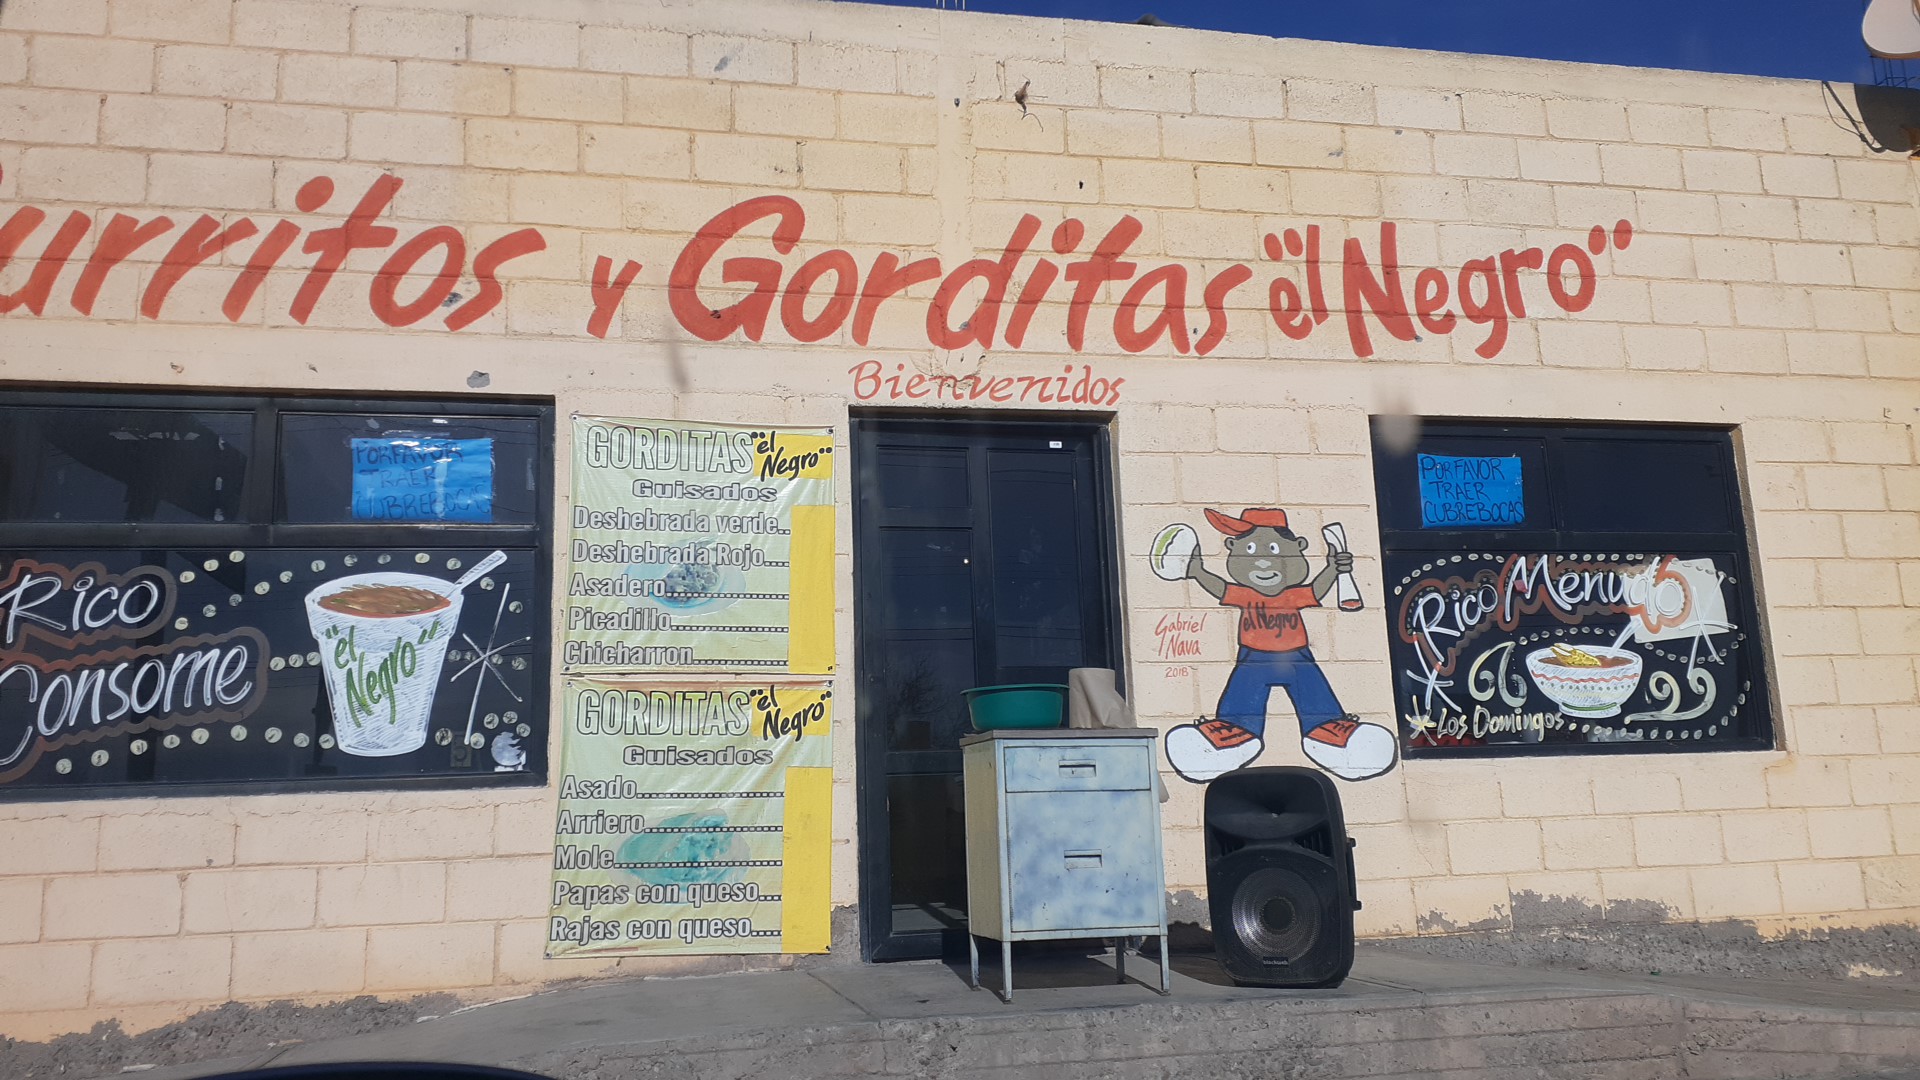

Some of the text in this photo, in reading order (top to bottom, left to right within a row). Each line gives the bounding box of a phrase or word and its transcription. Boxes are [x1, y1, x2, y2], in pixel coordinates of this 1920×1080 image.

[0, 163, 546, 333] urritos
[586, 254, 643, 339] y
[668, 195, 1253, 356] Gorditas
[848, 359, 1126, 406] Bienvenidos
[586, 425, 753, 474] GORDITAS
[632, 479, 777, 502] Guisados
[1429, 481, 1491, 501] TRAER
[1423, 500, 1525, 524] CUBREBOCAS
[0, 574, 158, 643] Rico
[1242, 601, 1298, 638] el Negro
[1412, 554, 1685, 662] Rico Menudo
[1155, 612, 1207, 656] Gabriel
[1166, 633, 1202, 659] Nava
[1164, 666, 1189, 677] 2018
[0, 645, 253, 766] Consome
[576, 689, 749, 736] GORDITAS
[1437, 705, 1565, 742] Los Domingos
[623, 745, 773, 765] Guisados
[553, 880, 629, 910] Papas
[635, 884, 680, 905] con
[550, 916, 619, 946] Rajas
[626, 920, 672, 941] con
